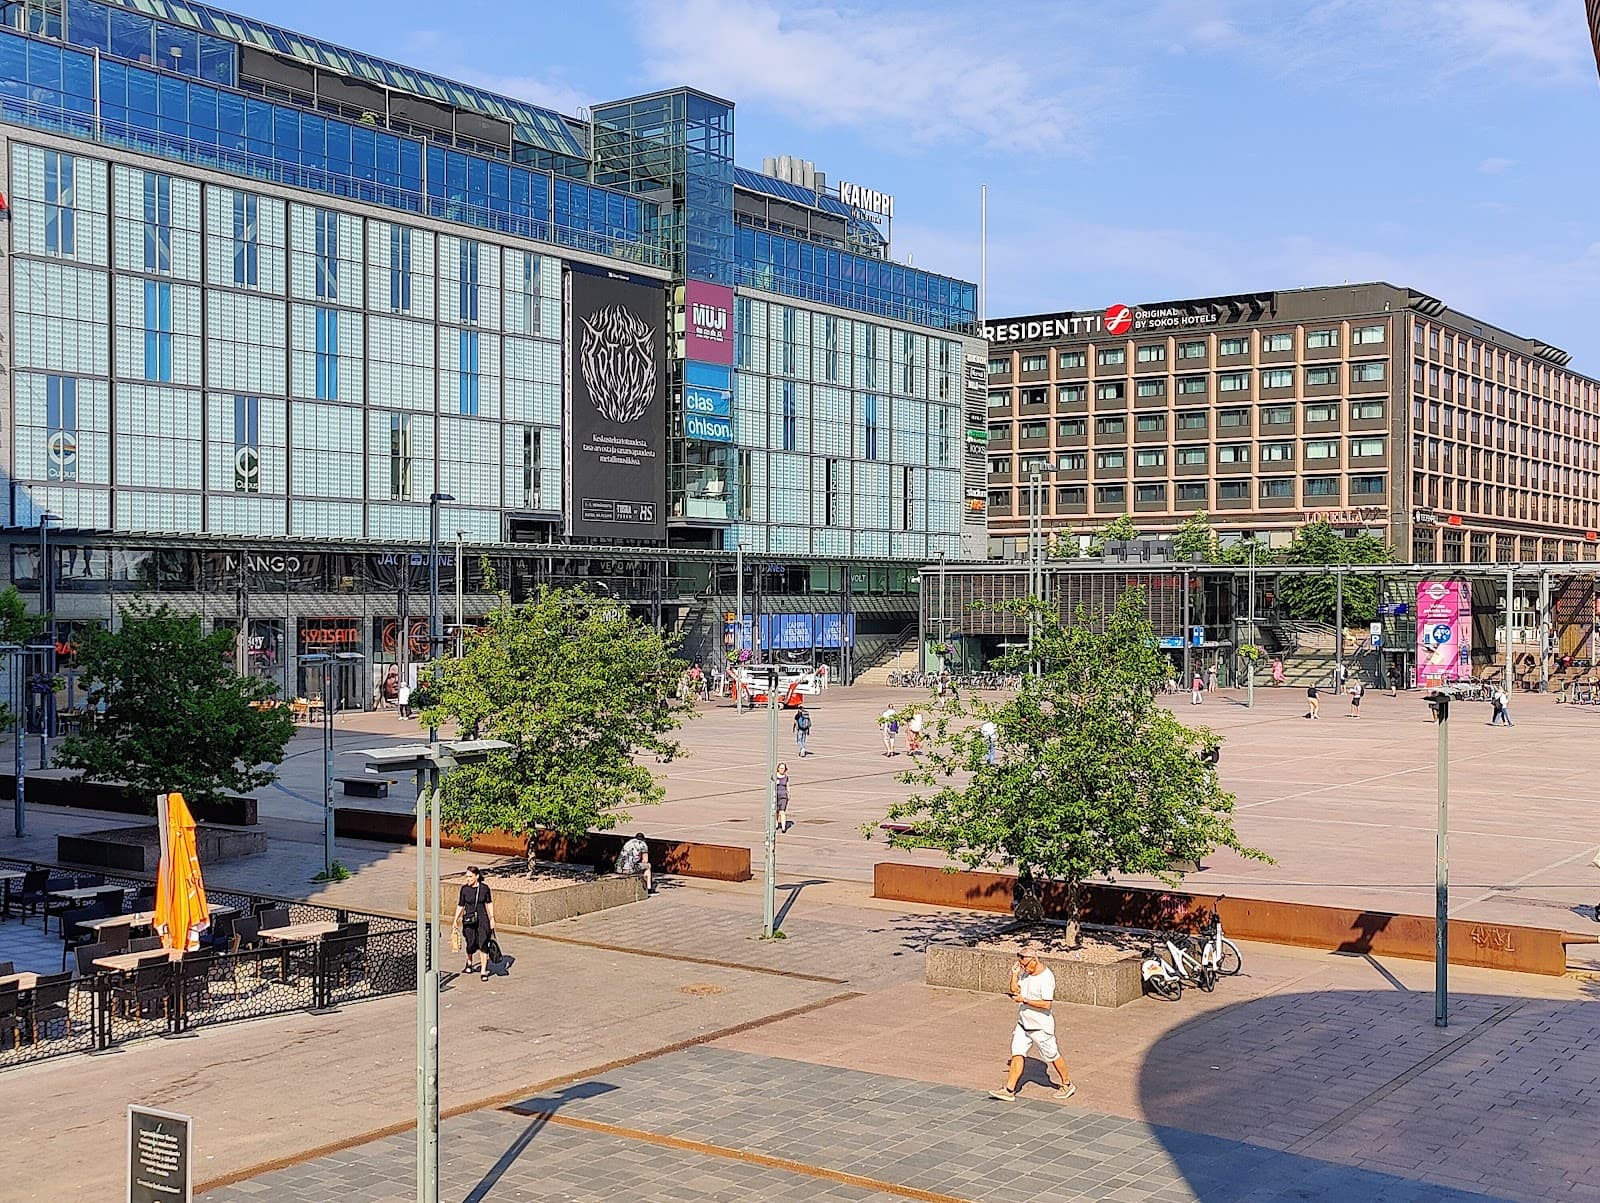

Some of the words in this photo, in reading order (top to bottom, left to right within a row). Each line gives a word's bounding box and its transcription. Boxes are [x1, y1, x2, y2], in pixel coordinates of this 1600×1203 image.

[840, 181, 894, 218] KAMPPI
[692, 302, 727, 330] MUJI
[1135, 308, 1178, 318] ORIGINAL
[1135, 320, 1147, 329] BY
[1149, 316, 1179, 328] SOKOS
[1181, 313, 1217, 325] HOTELS
[687, 391, 714, 411] clas
[640, 504, 653, 521] HS
[225, 555, 300, 573] MANGO
[850, 574, 867, 583] VOLT
[1371, 634, 1381, 645] P
